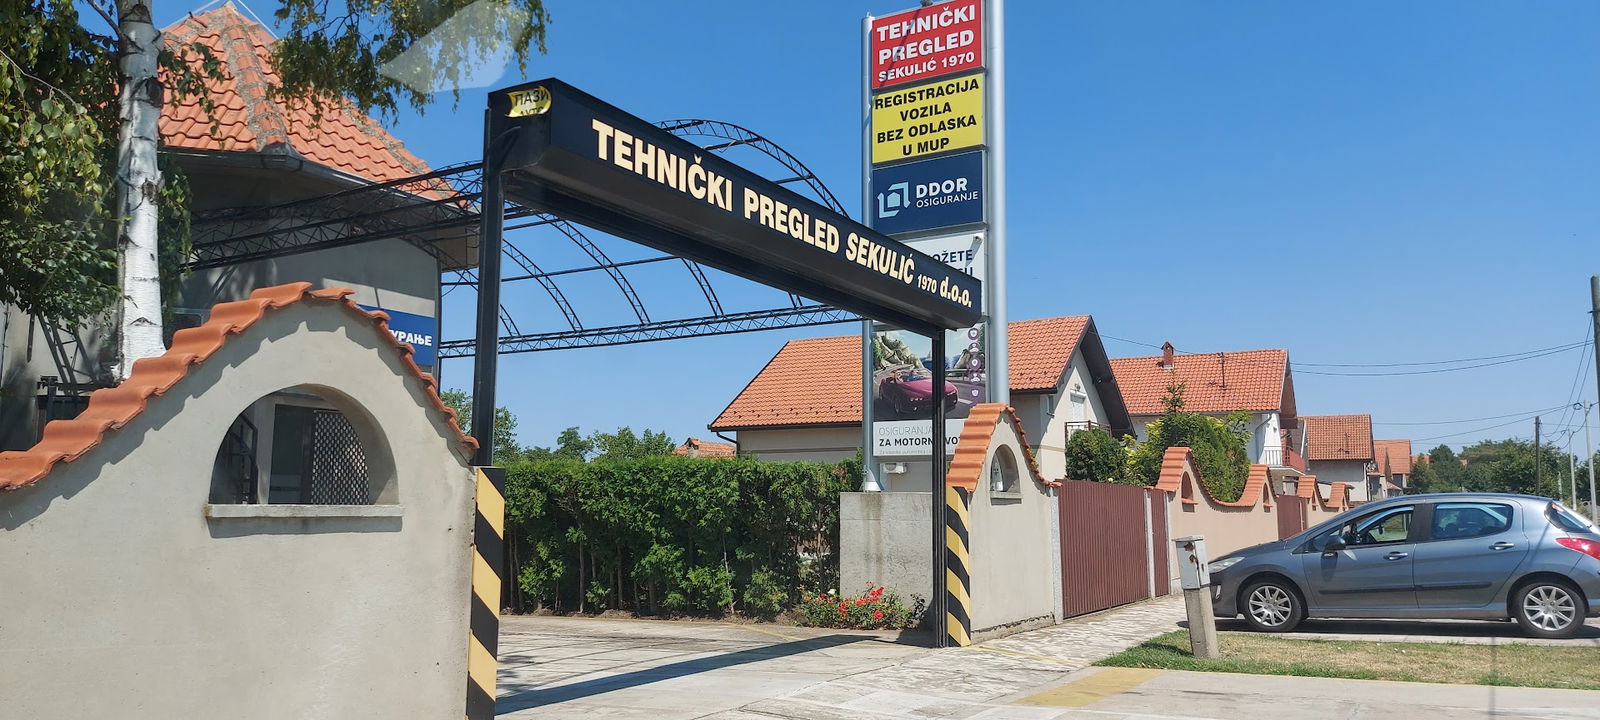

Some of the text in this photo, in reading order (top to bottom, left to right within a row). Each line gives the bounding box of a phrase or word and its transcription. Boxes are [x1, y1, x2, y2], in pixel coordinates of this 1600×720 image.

[876, 4, 976, 42] TEHNIČKI
[878, 29, 975, 65] PREGLED
[878, 51, 975, 82] SEKULIĆ 1970
[874, 78, 980, 110] REGISTRACIJA
[900, 101, 952, 122] VOZILA
[877, 114, 977, 144] BEZ ODLASKA
[902, 137, 950, 156] U MUP
[916, 177, 968, 199] DDOR
[916, 190, 979, 208] OSIGURANJE
[592, 118, 973, 308] TEHNIČKI PREGLED SEKULIĆ 1970 d.o.o.
[931, 249, 973, 265] OŽETE
[389, 330, 432, 346] УРАЊЕ
[879, 438, 892, 447] ZA
[894, 437, 934, 447] MOTORN
